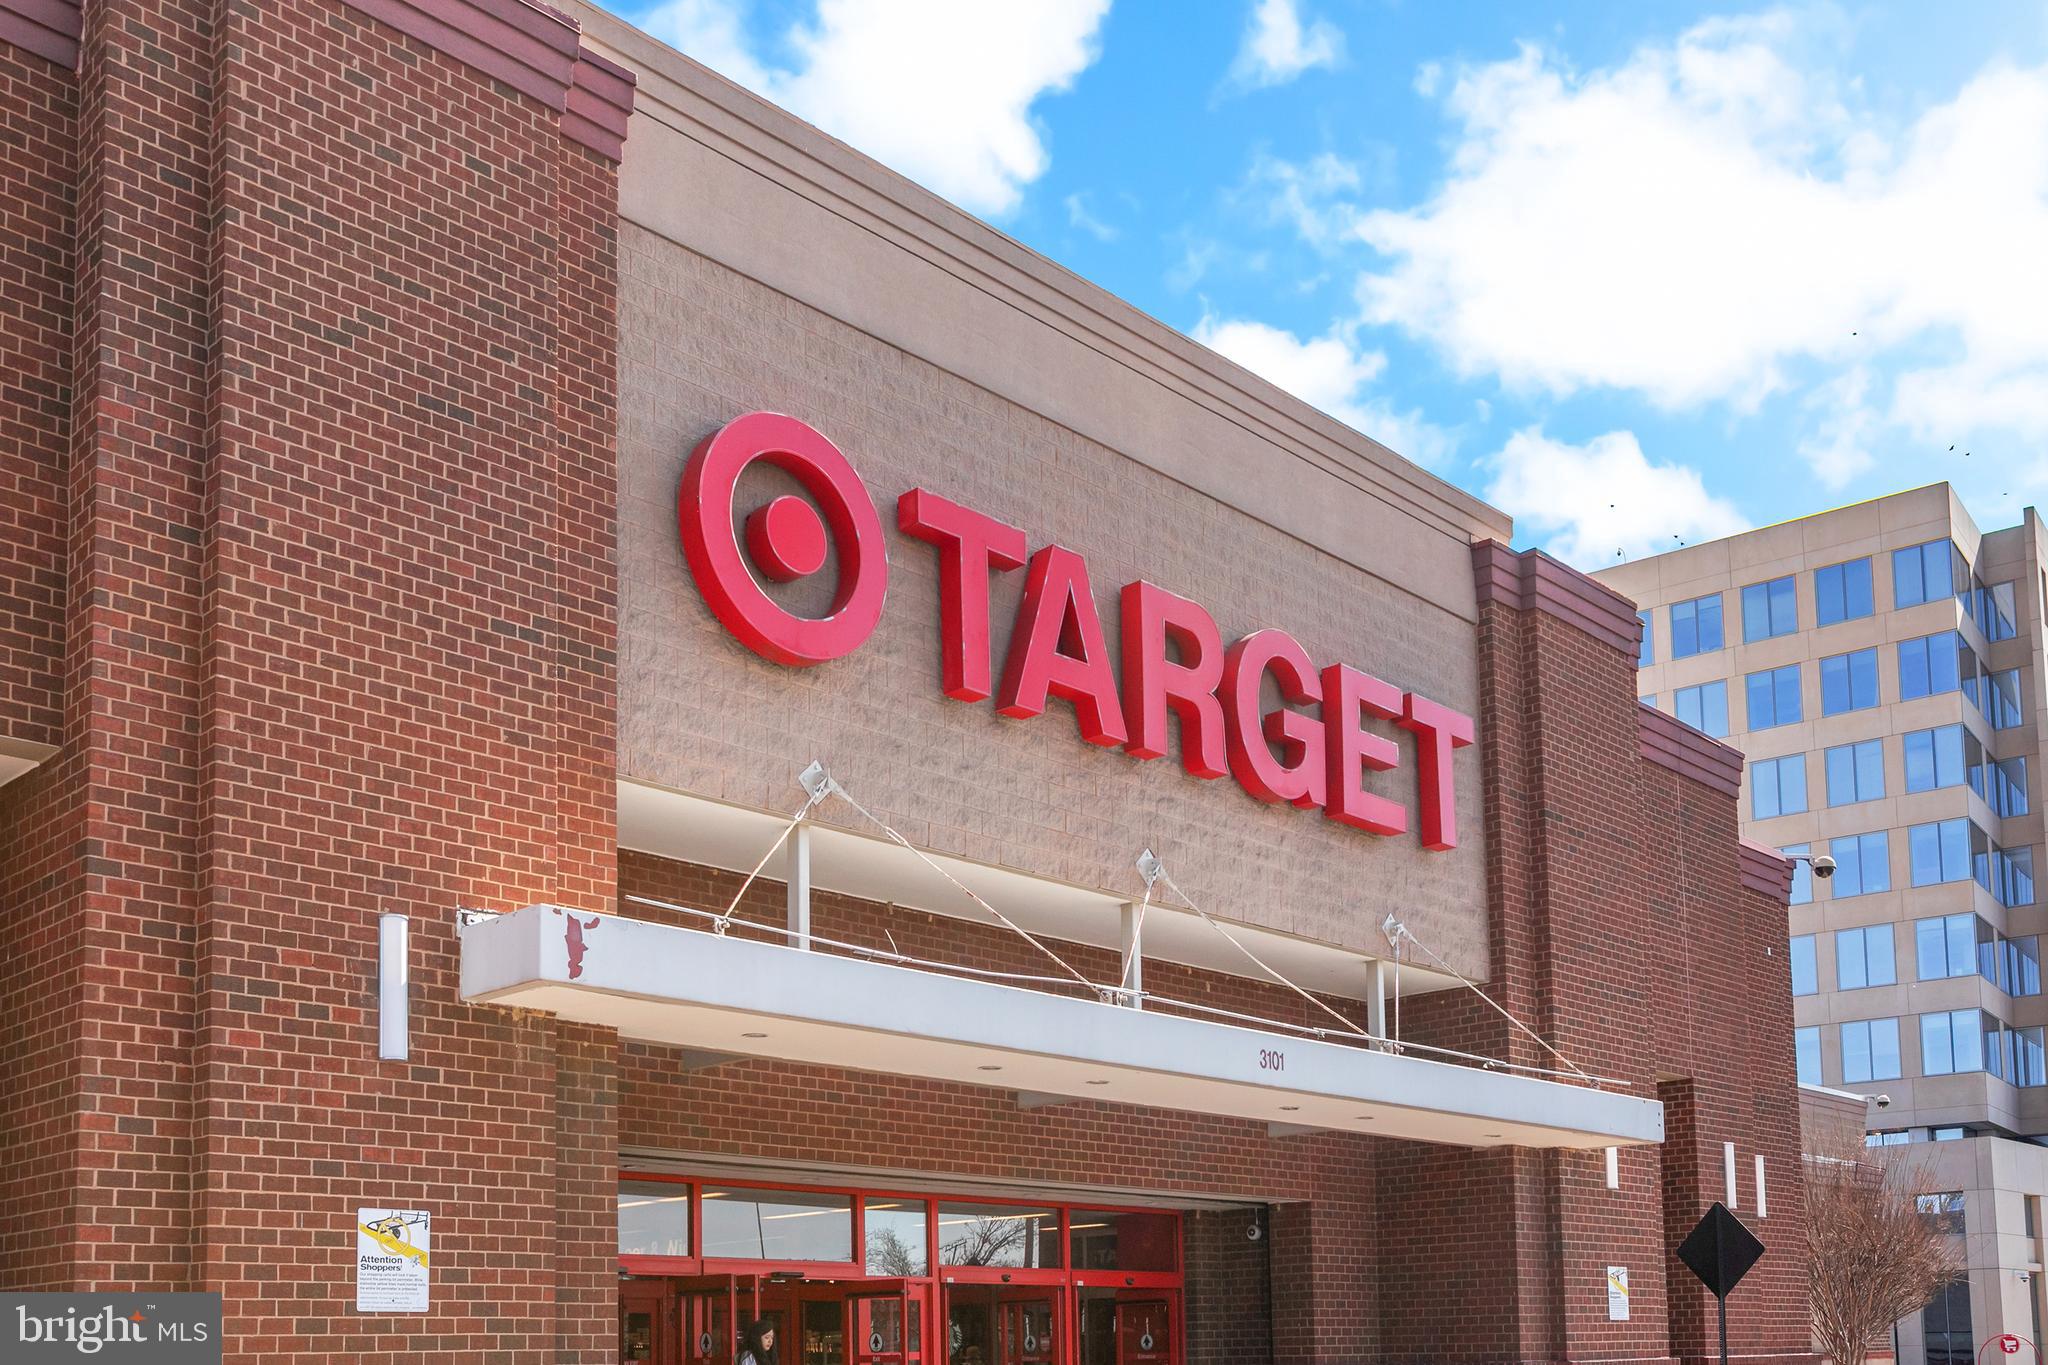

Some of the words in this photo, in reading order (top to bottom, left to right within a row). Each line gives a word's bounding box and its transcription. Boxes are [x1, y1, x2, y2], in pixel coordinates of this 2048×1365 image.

[897, 487, 1475, 852] TARGET
[1259, 1049, 1284, 1072] 3101
[360, 1255, 403, 1264] Attention
